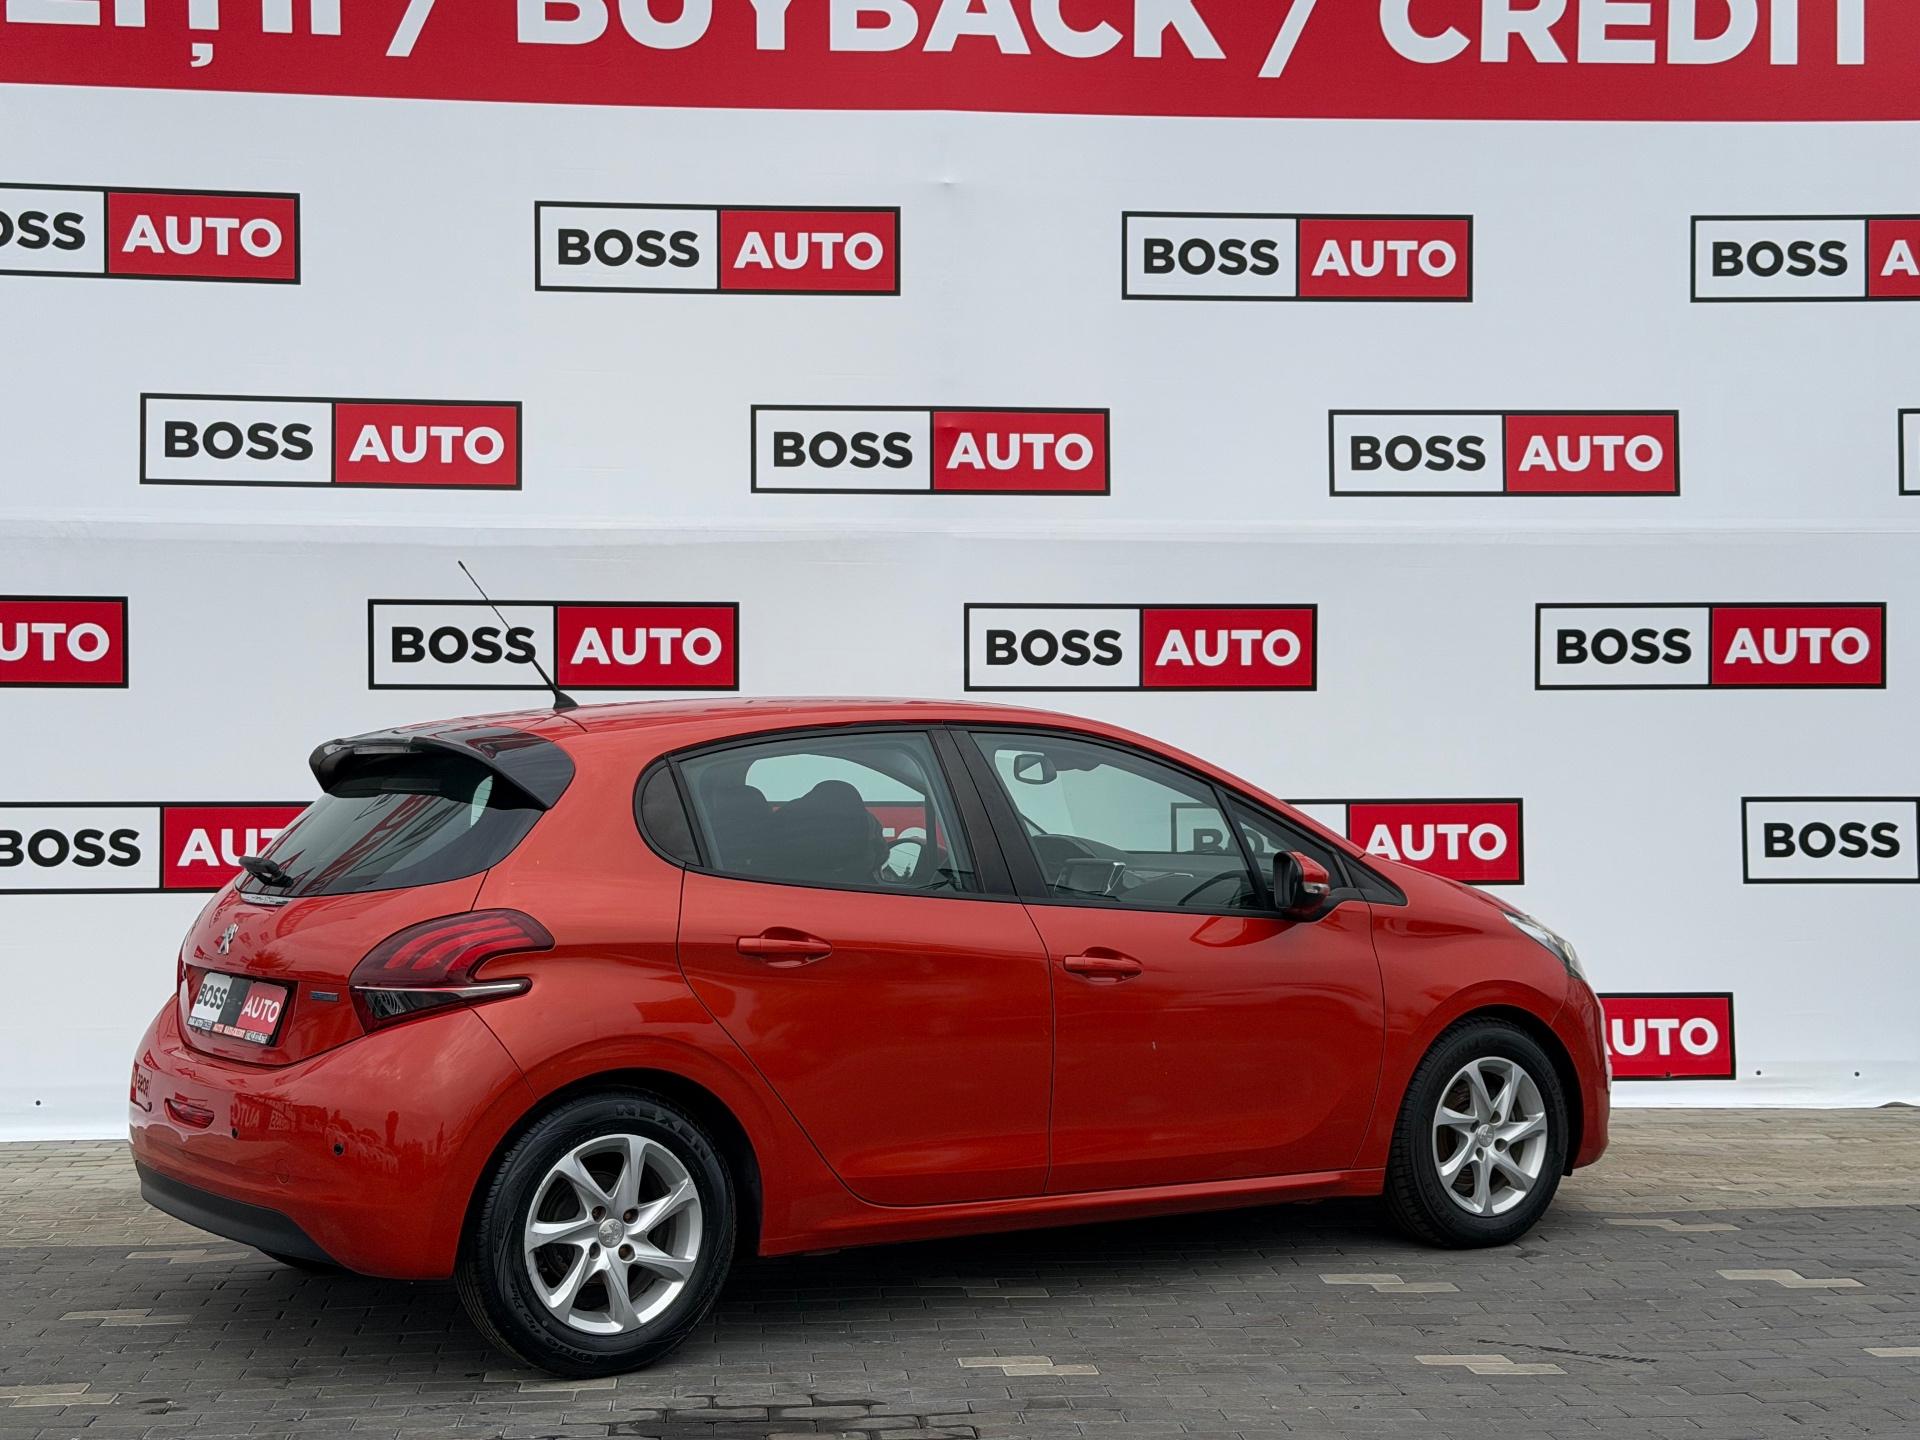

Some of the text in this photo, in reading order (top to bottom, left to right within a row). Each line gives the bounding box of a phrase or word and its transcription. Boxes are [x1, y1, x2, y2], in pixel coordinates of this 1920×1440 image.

[122, 214, 282, 257] AUTO
[559, 228, 883, 270] BOSS AUTO
[1144, 238, 1457, 277] BOSS AUTO
[1712, 240, 1847, 277] BOSS
[165, 421, 504, 464] BOSS AUTO
[774, 431, 1093, 470] BOSS AUTO
[1351, 434, 1663, 471] BOSS AUTO
[391, 626, 721, 665] BOSS AUTO
[987, 628, 1300, 666] BOSS AUTO
[1556, 627, 1869, 665] BOSS AUTO
[0, 828, 284, 868] BOSS AU
[1362, 823, 1507, 861] AUTO
[1763, 822, 1900, 858] BOSS
[196, 984, 281, 1023] BOSS AUTO
[1606, 1017, 1719, 1056] UTO
